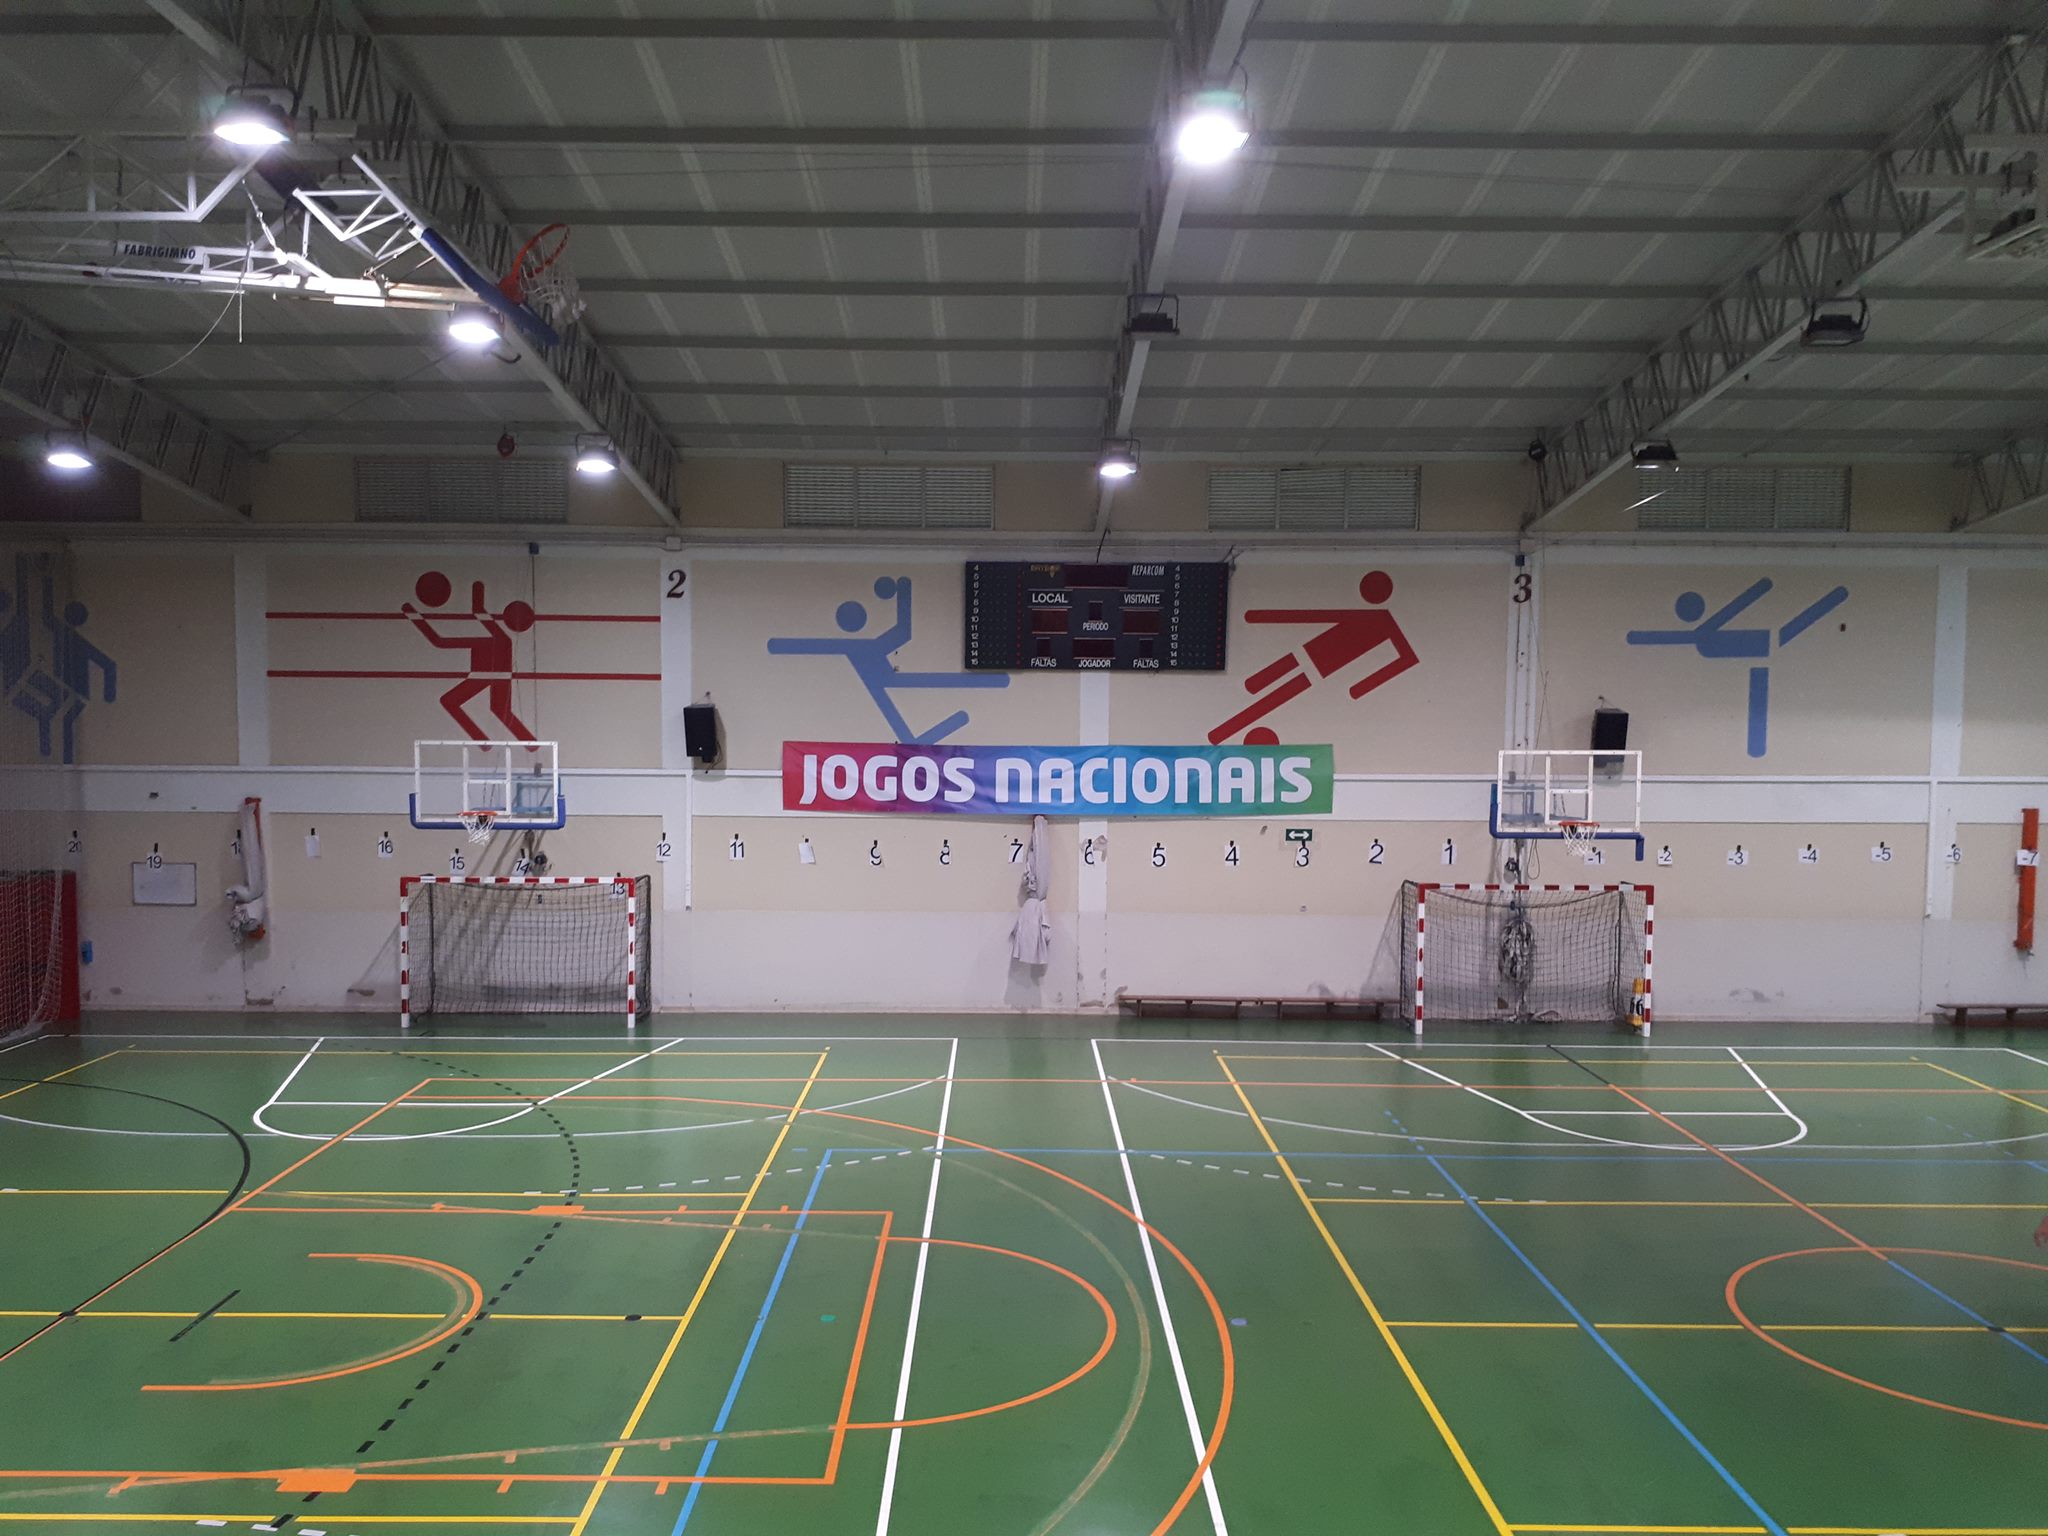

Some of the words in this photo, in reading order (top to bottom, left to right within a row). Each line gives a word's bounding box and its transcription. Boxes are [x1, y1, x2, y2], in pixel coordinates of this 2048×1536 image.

[124, 244, 196, 259] FABRIGIMNO
[1132, 565, 1165, 576] REPARCOM
[666, 569, 687, 598] 2
[1512, 574, 1532, 603] 3
[1032, 593, 1068, 604] LOCAL
[1124, 594, 1160, 604] VISITANTE
[1031, 658, 1057, 668] FALTAS
[1078, 659, 1111, 668] JOGADOR
[1133, 659, 1159, 668] FALTAS
[800, 755, 975, 805] JOGOS
[995, 757, 1312, 804] NACIONAIS
[377, 840, 393, 854] 16
[656, 843, 671, 857] 12
[730, 842, 744, 859] 11
[1010, 843, 1023, 863] 7
[1369, 843, 1384, 864] 2
[1875, 847, 1891, 861] -5
[1084, 844, 1094, 865] 6
[1152, 847, 1166, 867] 5
[1225, 846, 1239, 866] 4
[1296, 847, 1309, 867] 3
[1444, 845, 1453, 865] 1
[1588, 851, 1601, 864] -1
[1659, 850, 1671, 862] -2
[1728, 851, 1744, 865] -3
[1802, 850, 1817, 863] -4
[1946, 848, 1961, 861] -6
[2022, 851, 2038, 865] -7
[146, 855, 162, 869] 19
[449, 856, 465, 870] 15
[515, 860, 530, 874] 14
[610, 883, 625, 895] 13
